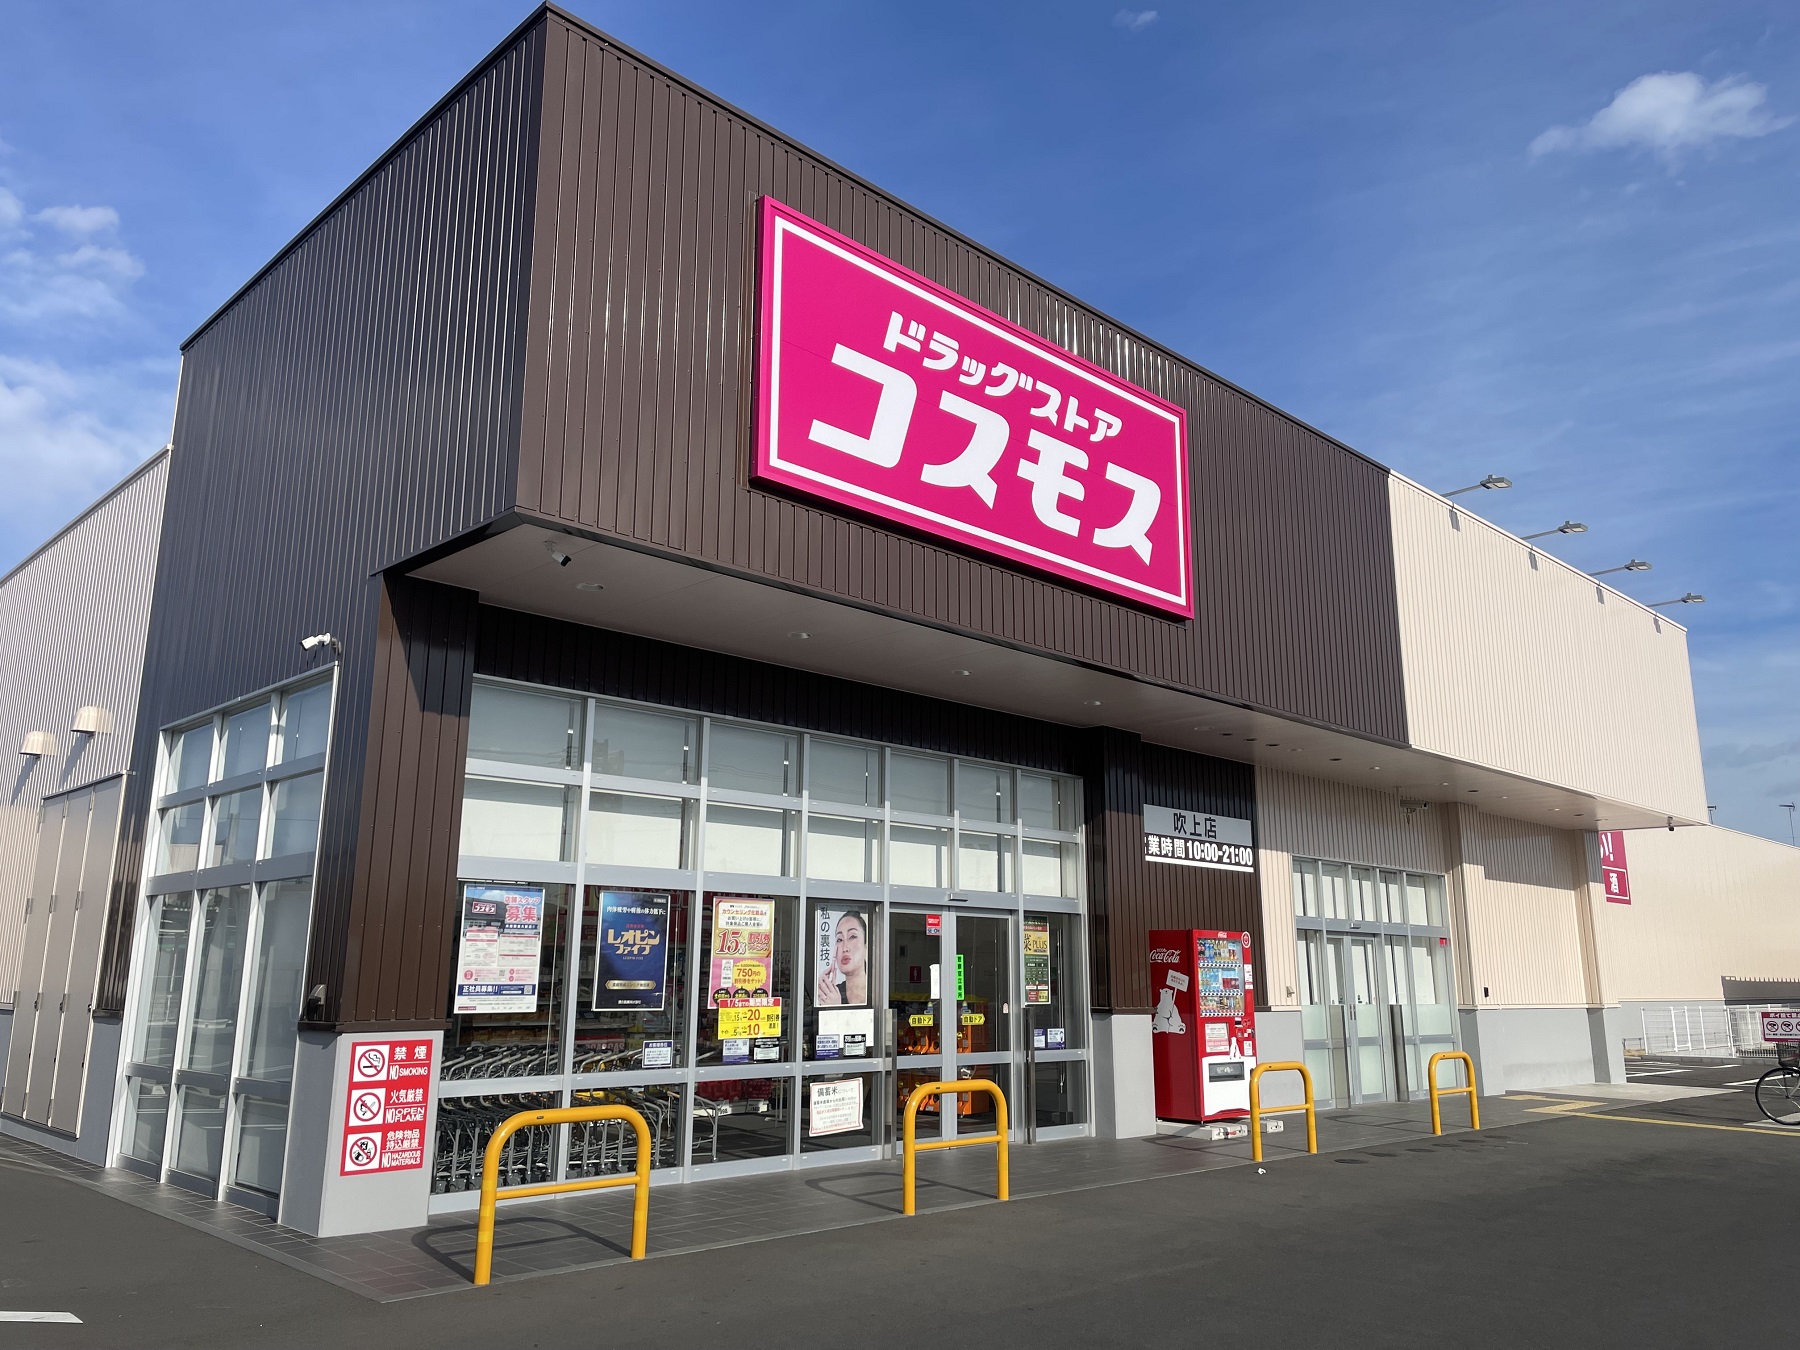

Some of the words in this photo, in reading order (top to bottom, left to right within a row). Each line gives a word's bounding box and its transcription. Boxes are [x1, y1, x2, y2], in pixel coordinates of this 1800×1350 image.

[882, 310, 1123, 442] ドラッグストア
[808, 342, 1162, 567] コスモス
[1173, 812, 1218, 840] 吹上店
[1609, 872, 1619, 893] 酒
[506, 905, 537, 922] 募集
[607, 928, 660, 945] レオピン
[820, 906, 830, 967] 私の裏技。
[614, 943, 652, 955] ファイブ
[1032, 939, 1048, 950] PLUS
[911, 1016, 932, 1024] 自動ドア
[963, 1015, 983, 1023] 自動ドア
[394, 1045, 427, 1060] 禁煙
[389, 1065, 399, 1080] NO
[399, 1066, 428, 1077] SMOKING
[390, 1088, 424, 1104] 火気厳禁
[385, 1108, 396, 1124] NO
[395, 1107, 425, 1115] OPEN
[395, 1113, 424, 1122] FLAME
[386, 1129, 420, 1140] 危険物品
[386, 1139, 419, 1151] 持込厳禁
[381, 1153, 391, 1168] NO
[391, 1150, 421, 1159] HAZARDOUS
[391, 1156, 420, 1167] MATERIALS
